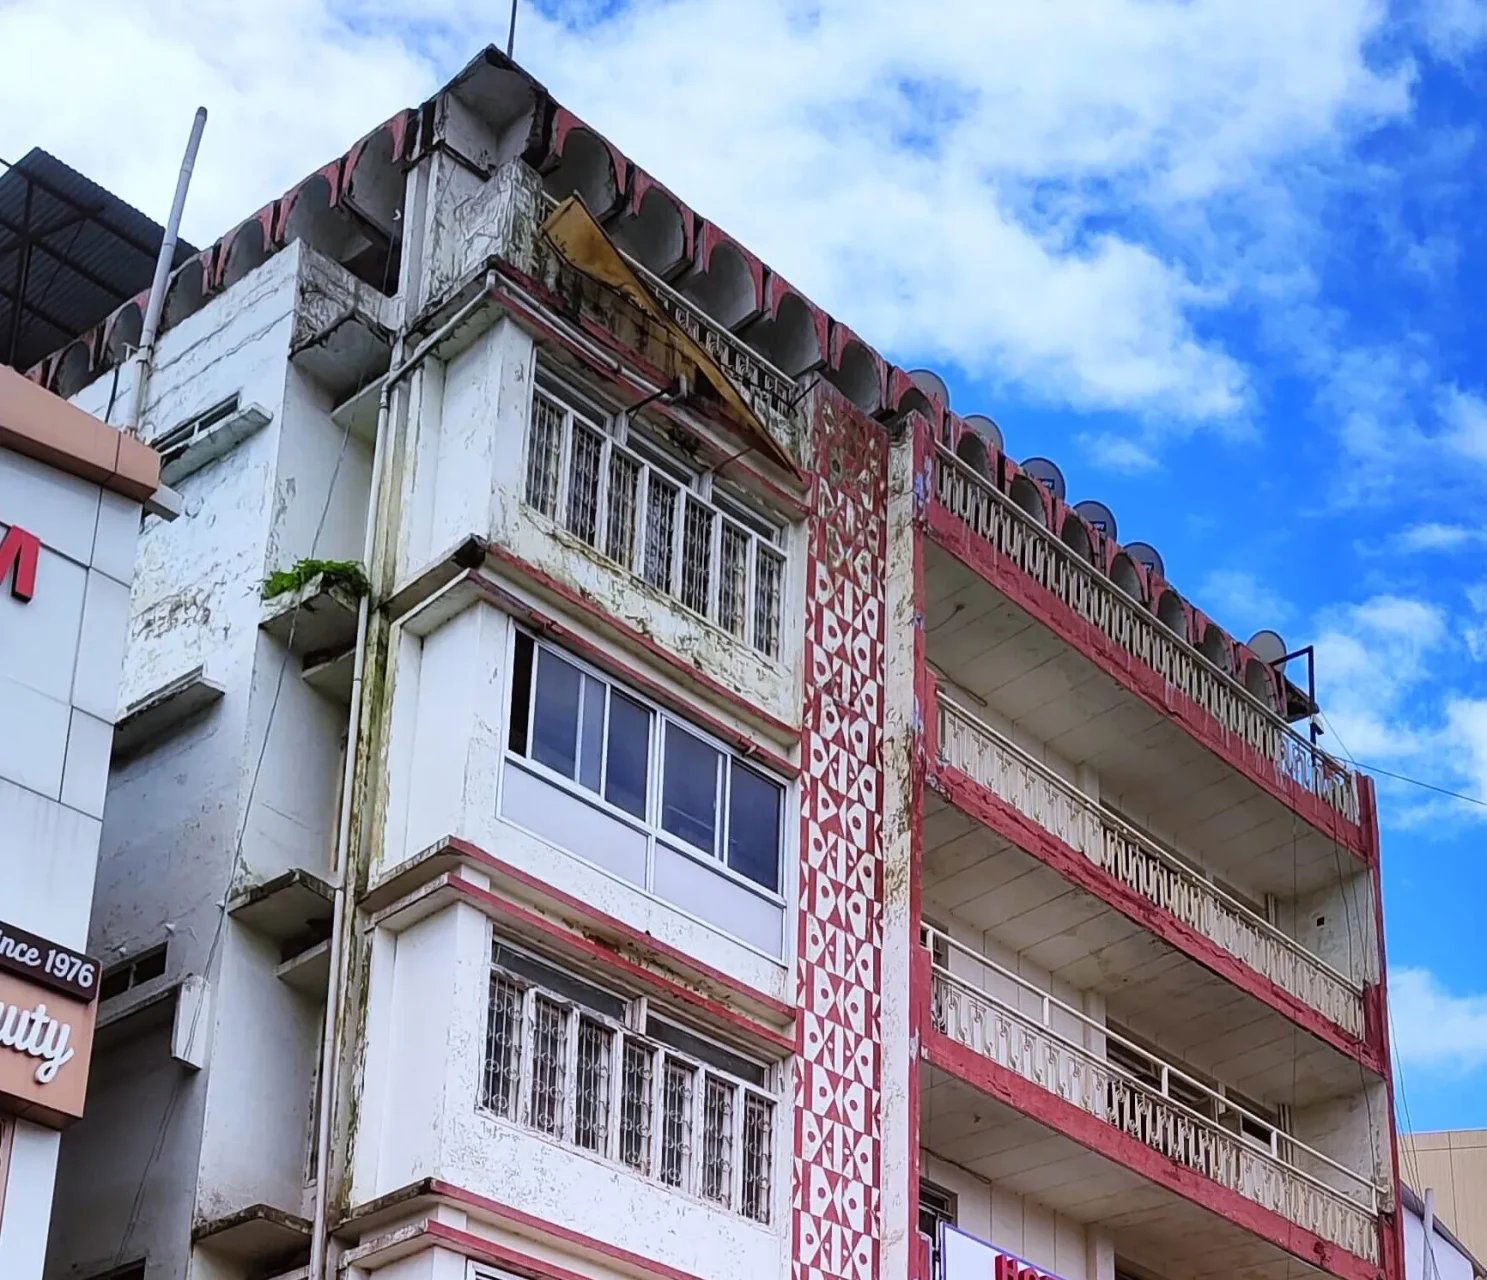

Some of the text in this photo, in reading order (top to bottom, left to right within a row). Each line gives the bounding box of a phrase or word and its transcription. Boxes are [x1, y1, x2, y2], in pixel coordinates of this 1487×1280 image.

[0, 929, 95, 988] ince 1976
[0, 1002, 74, 1084] uty
